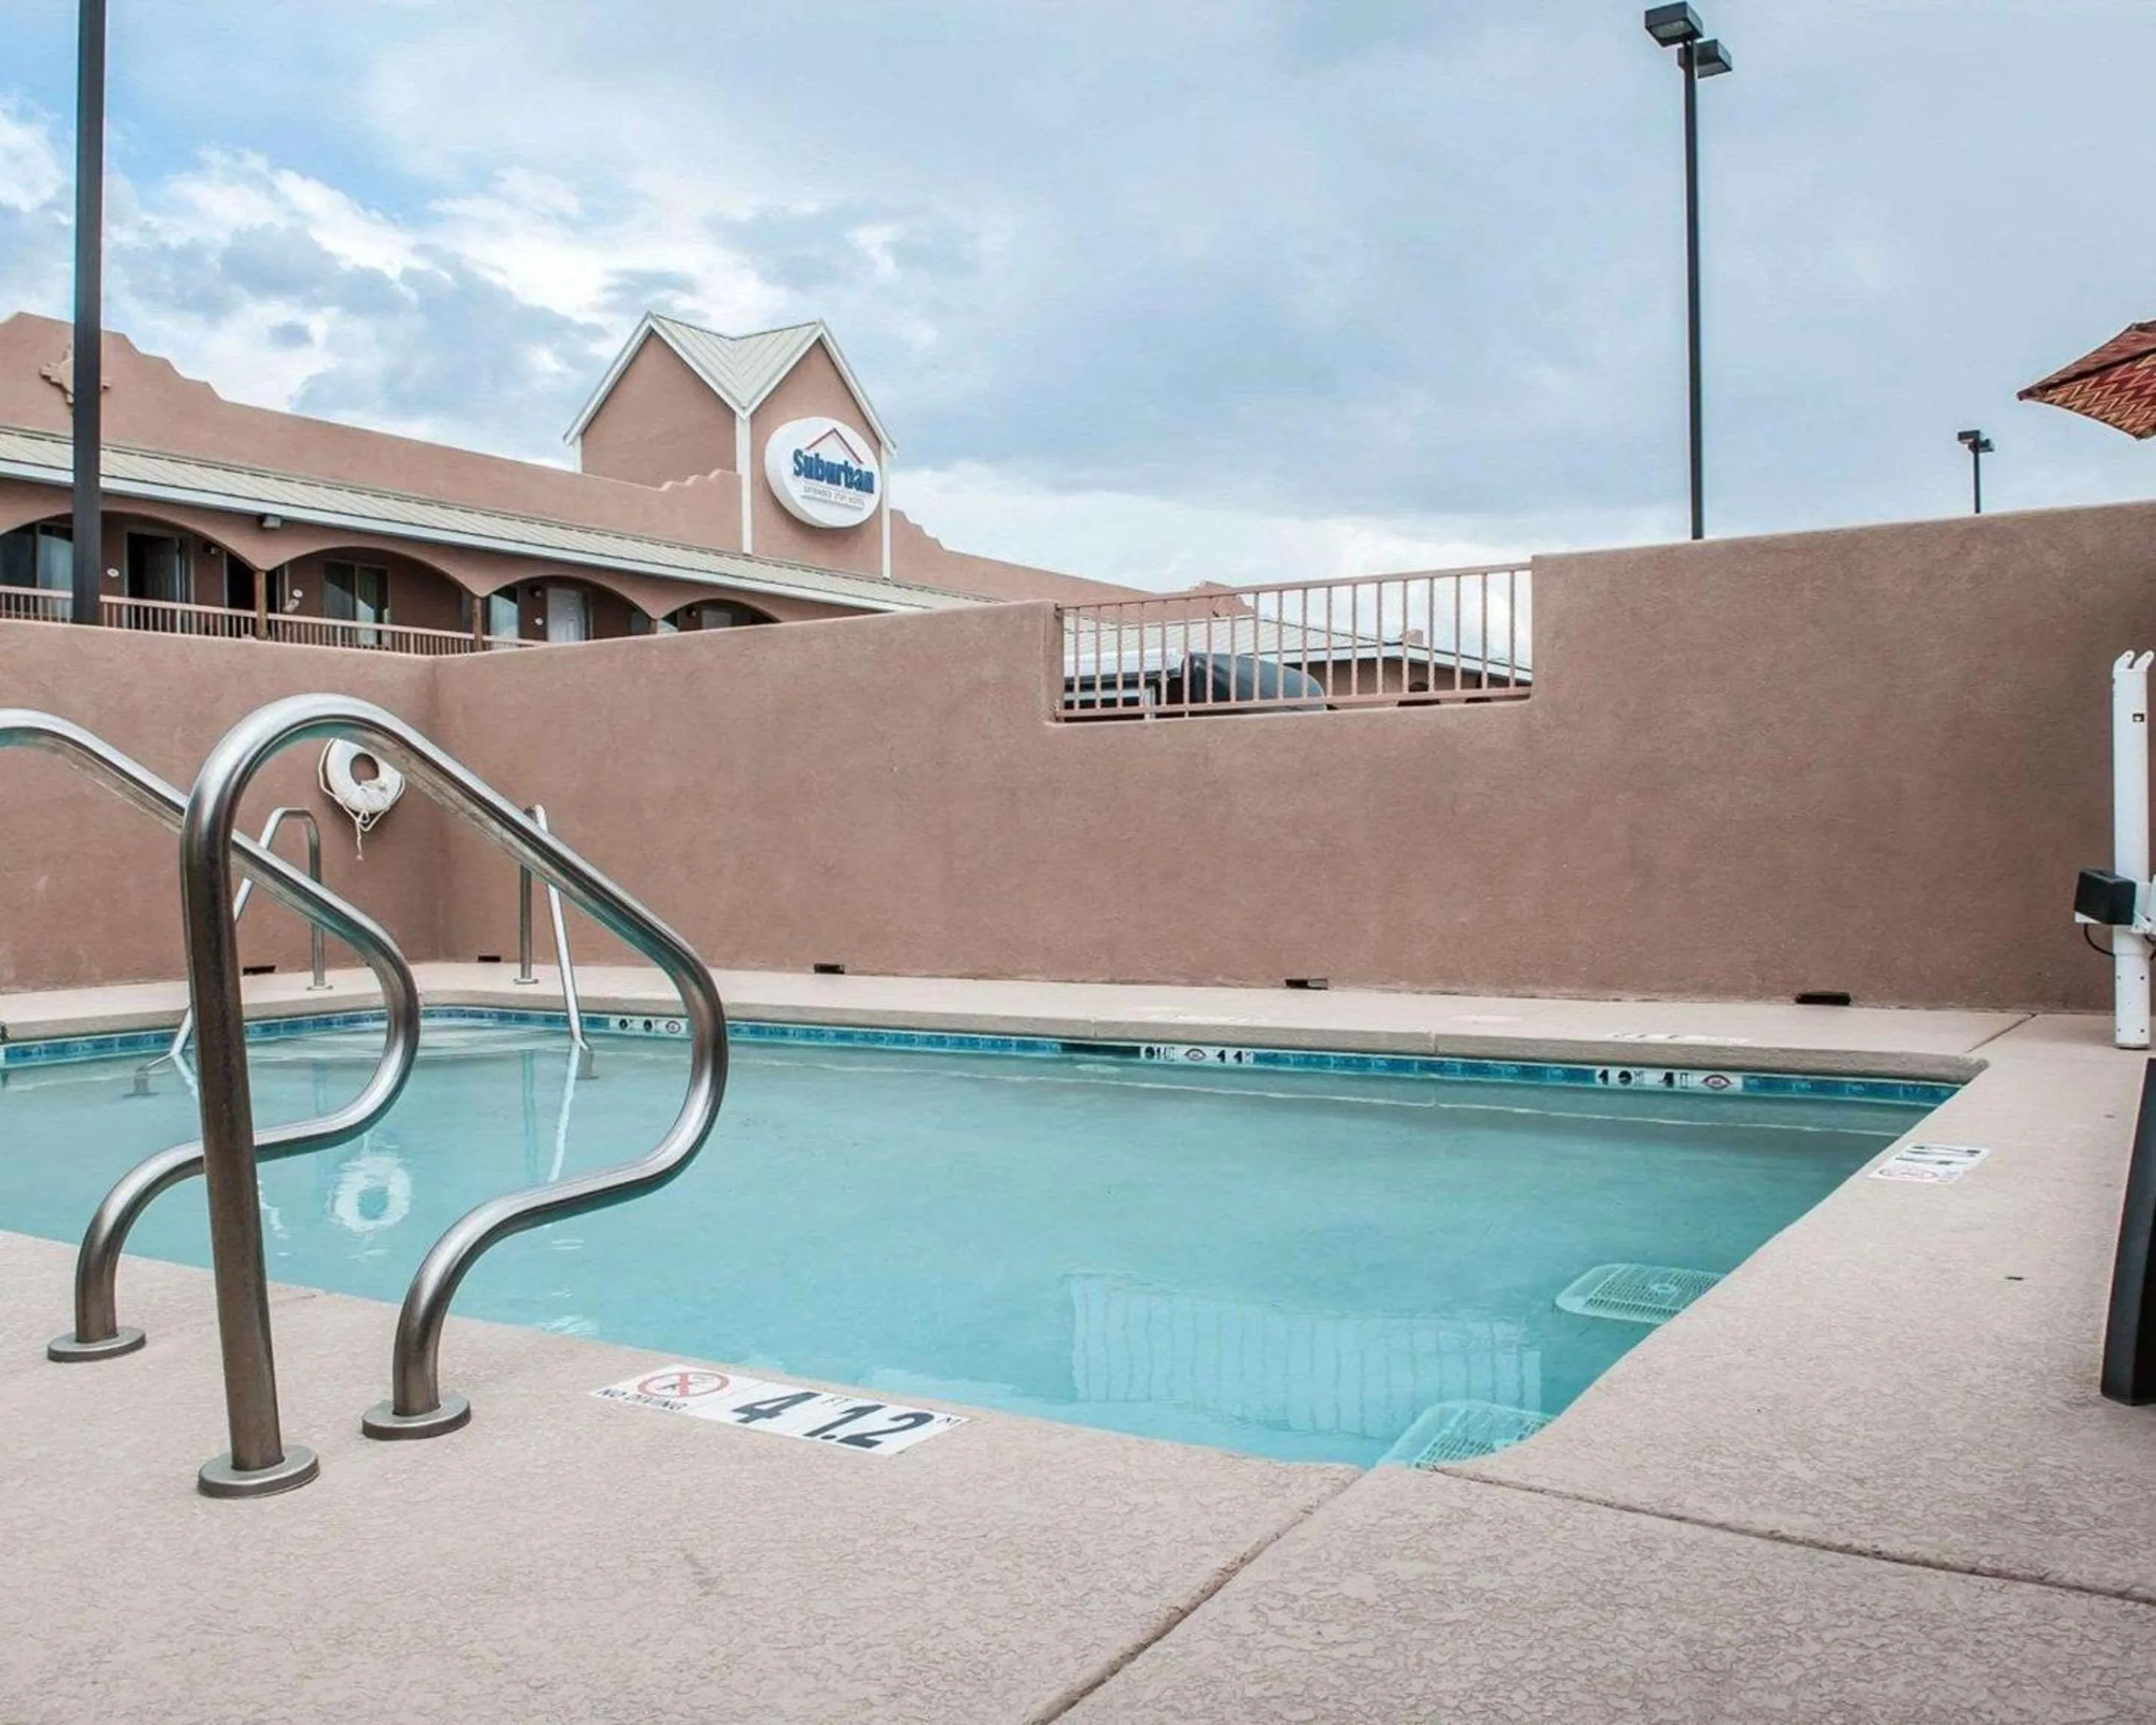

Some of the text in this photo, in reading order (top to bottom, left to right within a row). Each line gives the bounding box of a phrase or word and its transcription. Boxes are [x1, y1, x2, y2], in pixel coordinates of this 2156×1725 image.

[793, 448, 874, 494] Suburban
[731, 1391, 822, 1424] 4
[802, 1404, 935, 1449] 1.2
